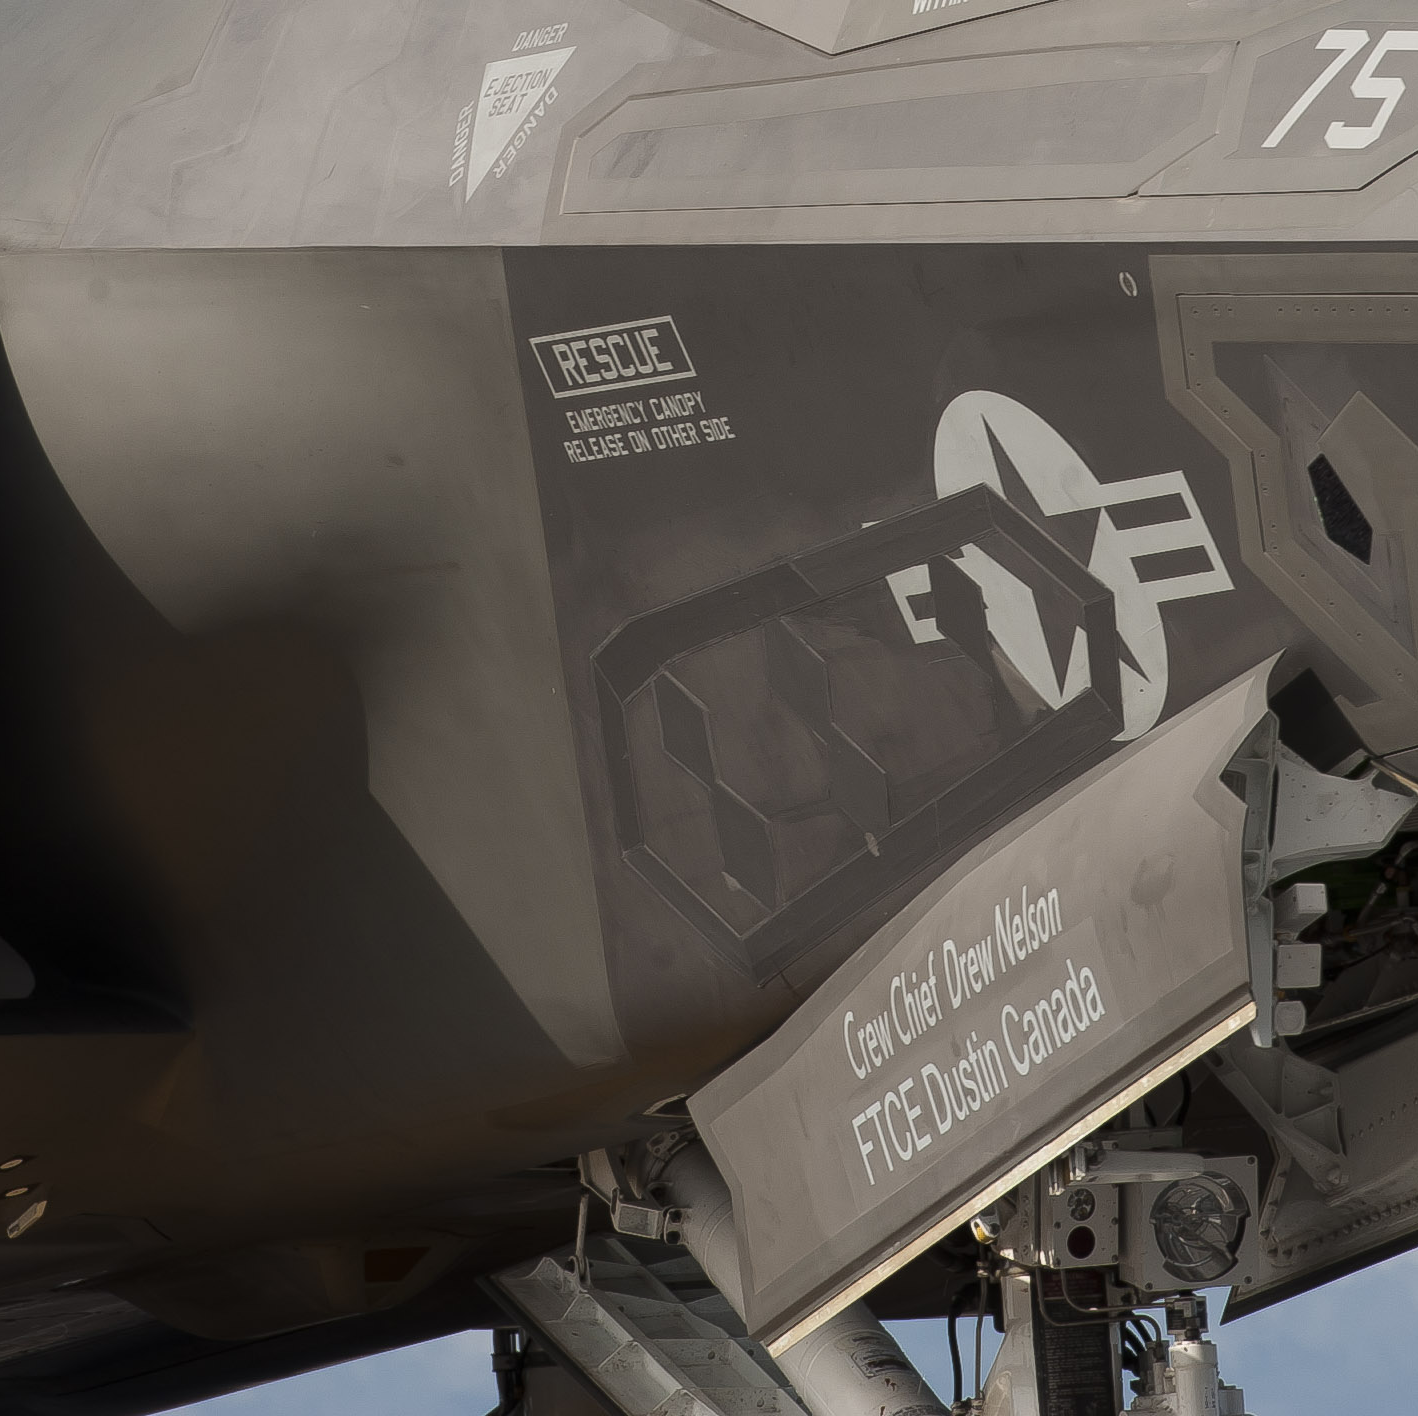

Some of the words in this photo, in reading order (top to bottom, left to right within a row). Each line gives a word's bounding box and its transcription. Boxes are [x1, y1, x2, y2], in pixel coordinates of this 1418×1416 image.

[512, 22, 568, 52] DANGER
[483, 68, 553, 98] EJECTION
[488, 93, 528, 118] SEAT
[449, 100, 474, 187] DANGER
[493, 86, 559, 179] DANGER
[552, 329, 674, 386] RESCUE
[565, 401, 648, 433] EMERGENCY
[649, 391, 706, 421] CANOPY
[564, 434, 629, 463] RELEASE
[628, 430, 652, 453] ON
[651, 422, 701, 450] OTHER
[699, 417, 736, 442] SIDE
[843, 1011, 895, 1080] Crew
[891, 951, 943, 1045] Chief
[943, 935, 995, 1009] Drew
[995, 885, 1063, 973] Nelson
[852, 1077, 932, 1185] FTCE
[921, 1031, 1009, 1134] Dustin
[1001, 958, 1106, 1076] Canada
